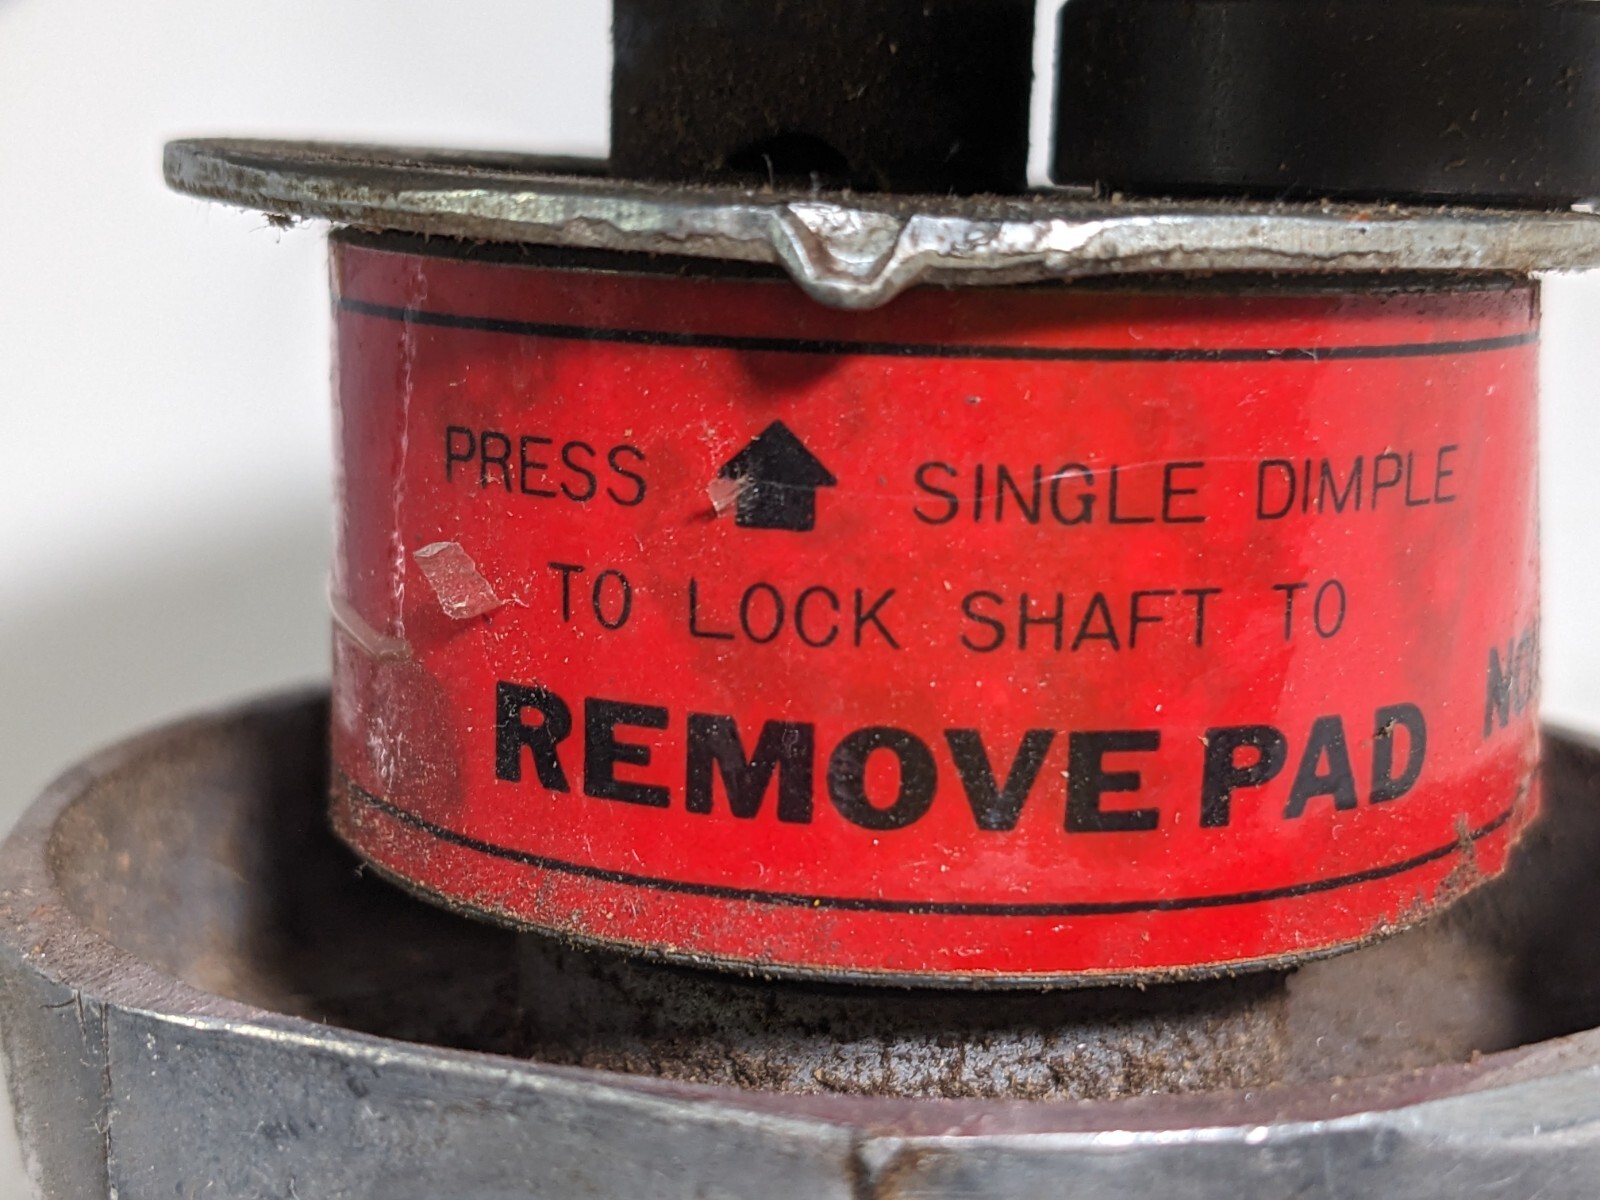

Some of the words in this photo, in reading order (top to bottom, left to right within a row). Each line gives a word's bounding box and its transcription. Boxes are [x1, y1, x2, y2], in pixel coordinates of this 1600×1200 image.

[445, 425, 647, 507] PRESS
[914, 461, 1206, 526] SINGLE
[1257, 445, 1456, 520] DIMPLE
[549, 562, 632, 630] TO
[688, 578, 899, 649] LOCK
[961, 587, 1222, 653] SHAFT
[1272, 579, 1346, 639] TO
[495, 680, 1161, 834] REMOVE
[1199, 703, 1427, 829] PAD
